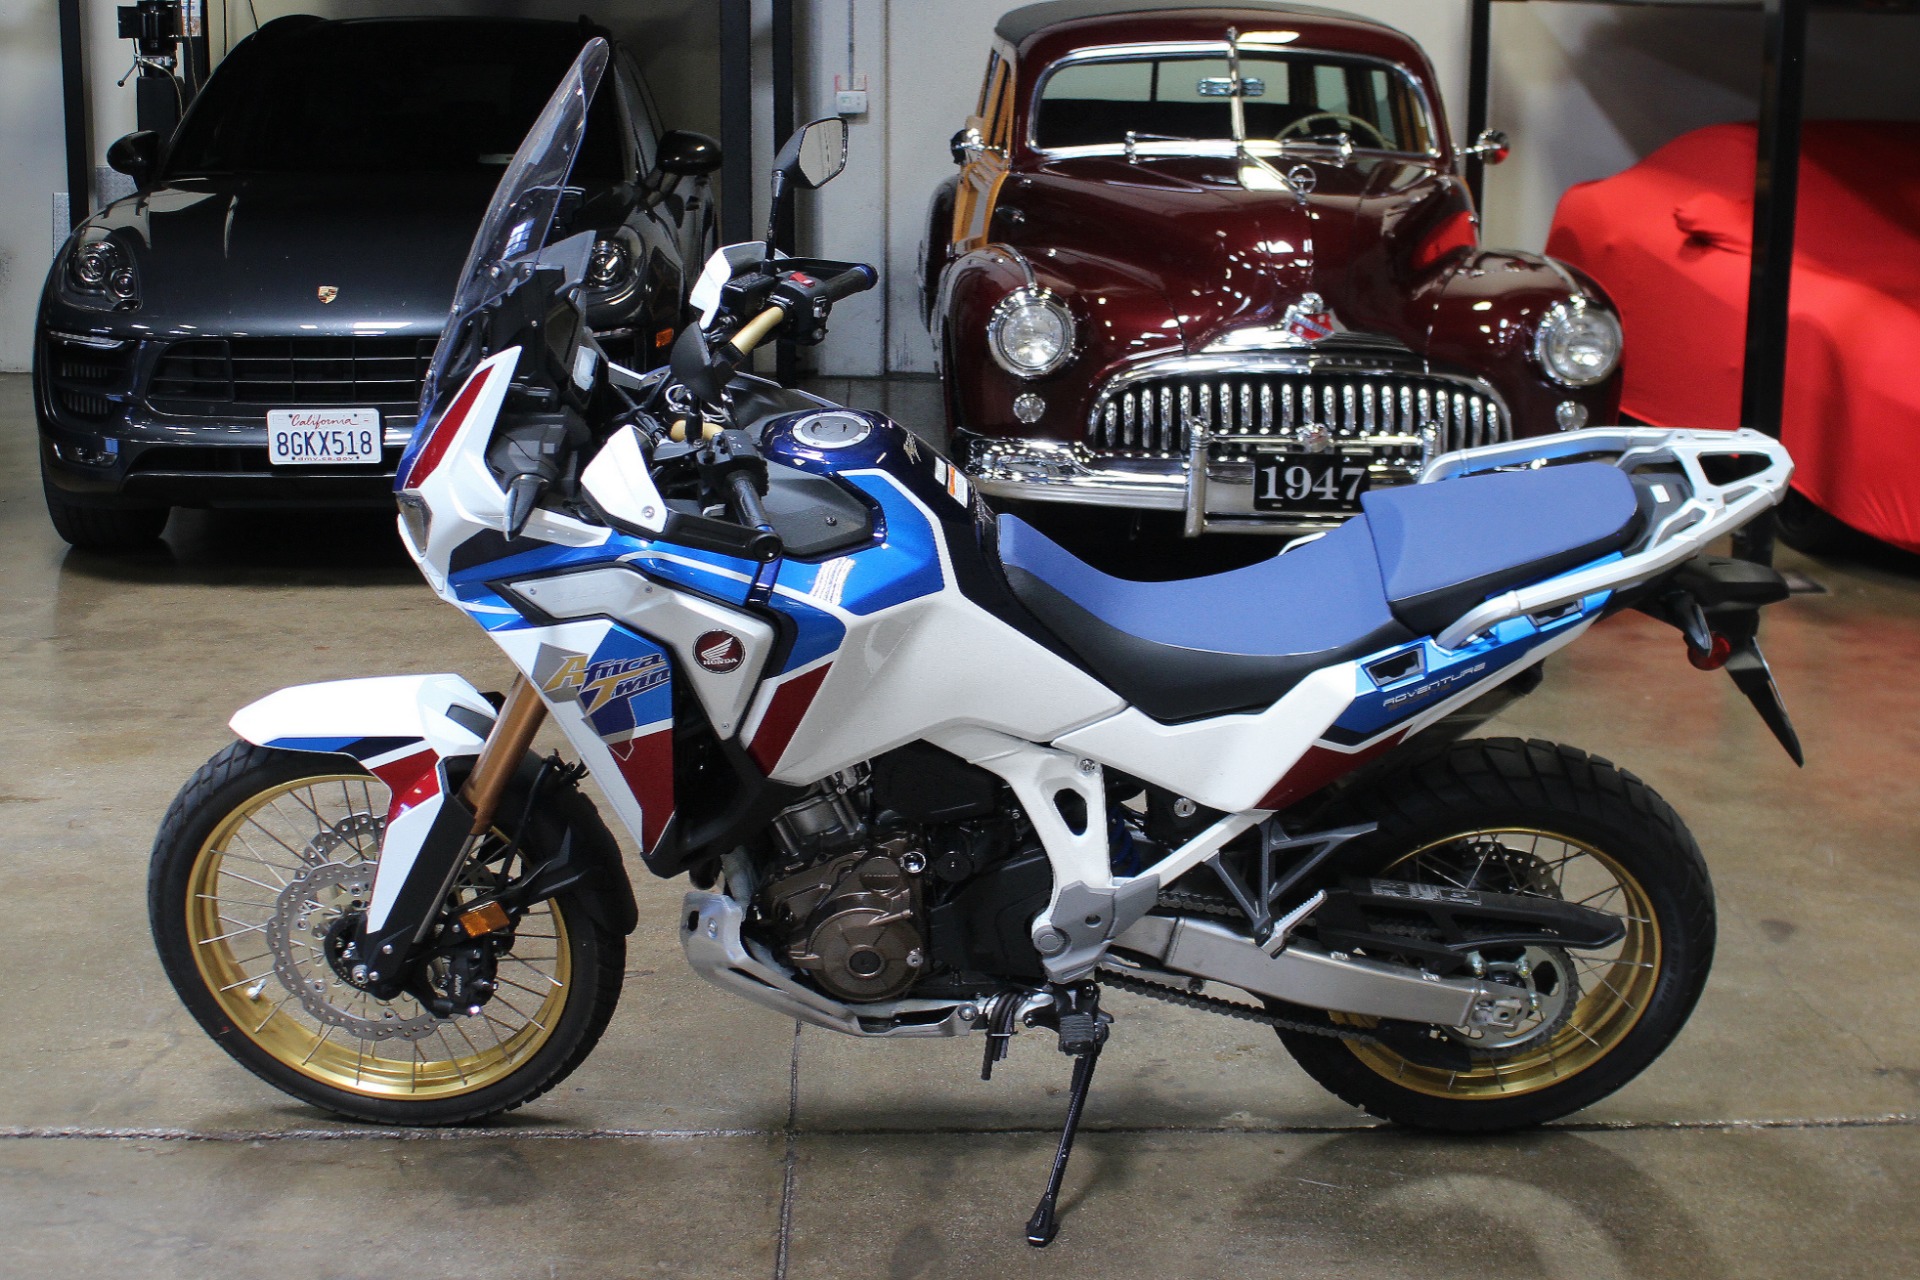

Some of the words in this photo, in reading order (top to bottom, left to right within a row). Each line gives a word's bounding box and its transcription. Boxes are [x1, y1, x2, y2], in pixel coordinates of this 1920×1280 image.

[291, 414, 359, 429] California
[276, 431, 372, 456] 8GKX518
[1259, 466, 1366, 501] 1947
[542, 653, 662, 695] Africa
[703, 657, 738, 665] HONDA
[580, 660, 671, 717] Twin
[1383, 662, 1486, 707] ADVENTURE
